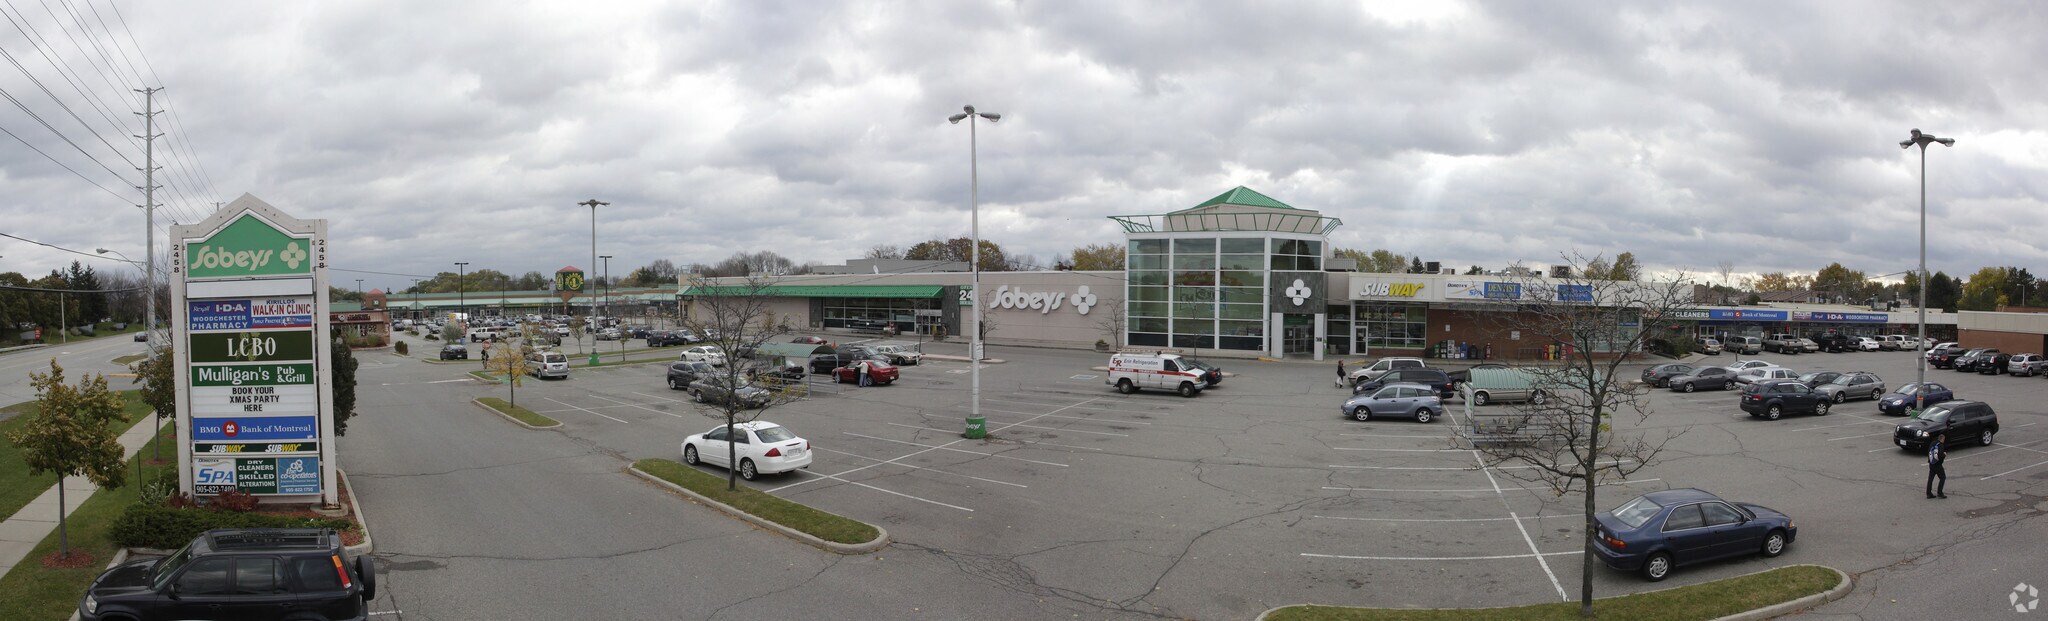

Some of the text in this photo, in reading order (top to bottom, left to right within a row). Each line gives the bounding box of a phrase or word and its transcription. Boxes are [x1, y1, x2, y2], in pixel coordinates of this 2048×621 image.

[190, 245, 273, 271] Sobeys
[1360, 283, 1424, 297] SUBWAY
[989, 285, 1066, 314] Sobeys
[252, 303, 311, 315] WALK-IN CLINIC
[227, 337, 276, 357] LCBO
[199, 366, 270, 385] Mulligan's
[277, 366, 295, 375] Pub
[232, 387, 253, 395] BOOK
[253, 395, 279, 403] PARTY
[244, 404, 263, 412] HERE
[200, 424, 311, 434] BMO Bank of Montreal
[209, 444, 245, 453] SUBWAY
[265, 443, 301, 452] SUBWAY
[197, 468, 234, 483] SPA
